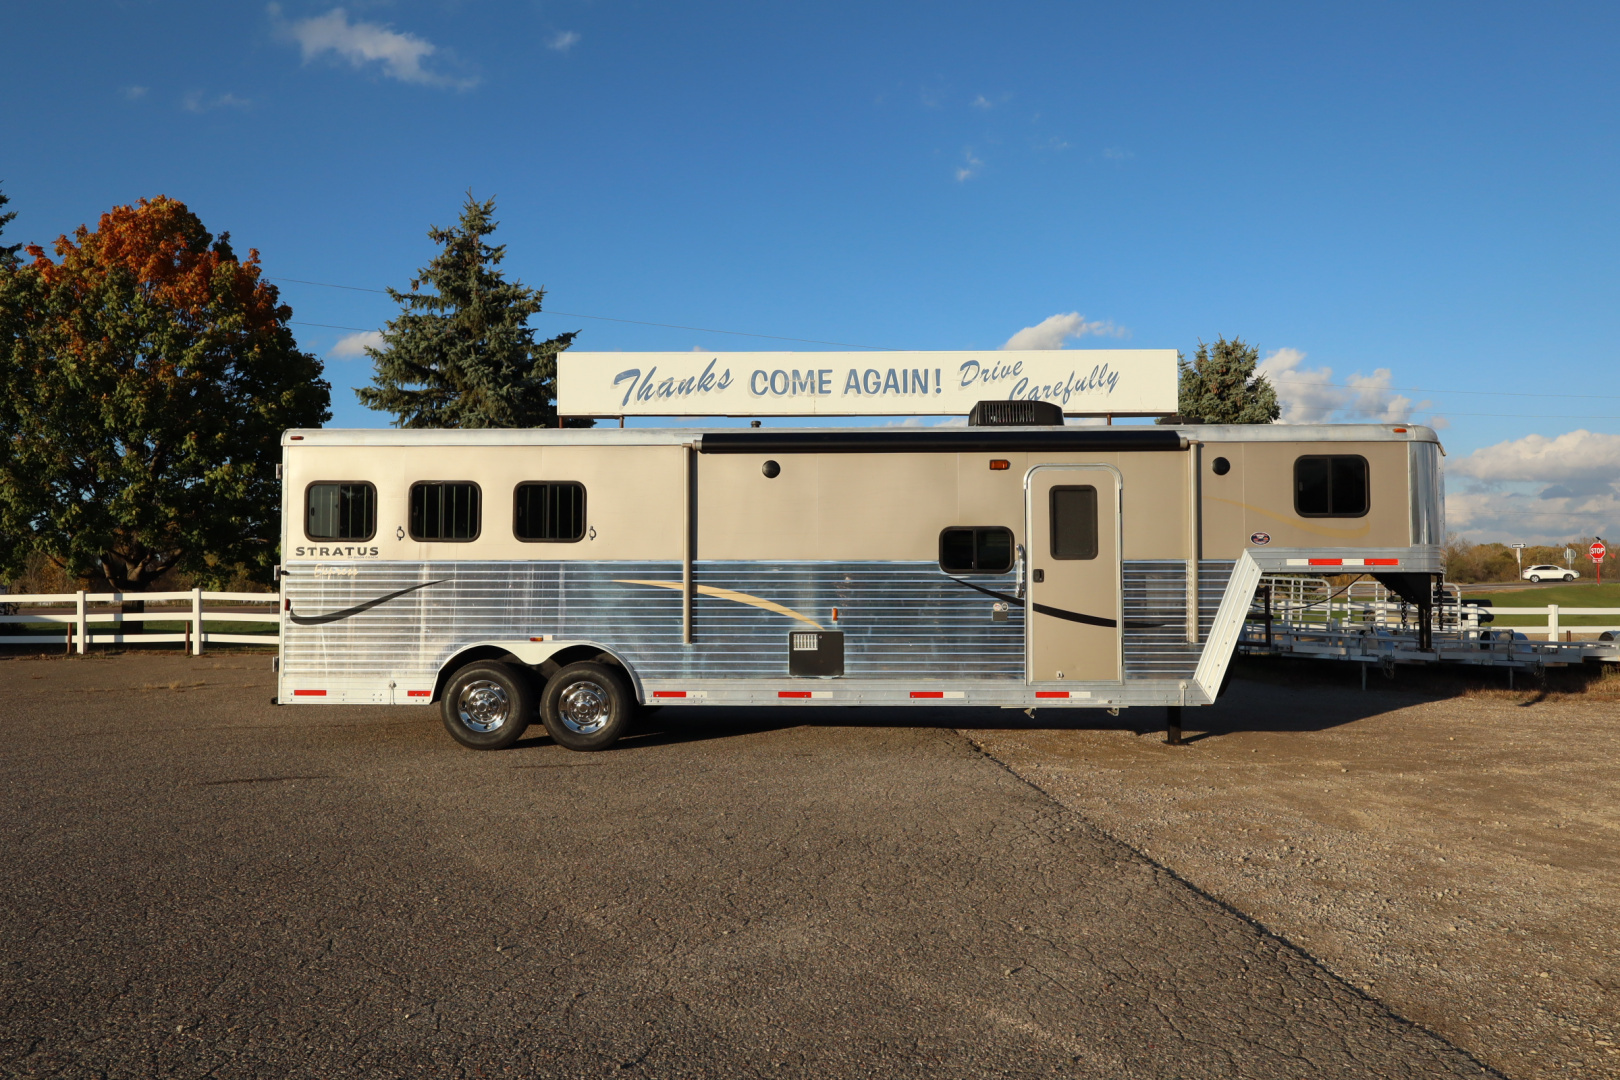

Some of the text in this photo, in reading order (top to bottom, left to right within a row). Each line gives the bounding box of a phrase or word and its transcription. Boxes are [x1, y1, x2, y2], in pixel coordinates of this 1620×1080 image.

[613, 357, 942, 407] Thanks COME AGAIN!
[959, 359, 1024, 387] Drive
[1008, 362, 1120, 405] Carefully
[295, 546, 379, 556] STRATUS
[1590, 547, 1604, 555] STOP
